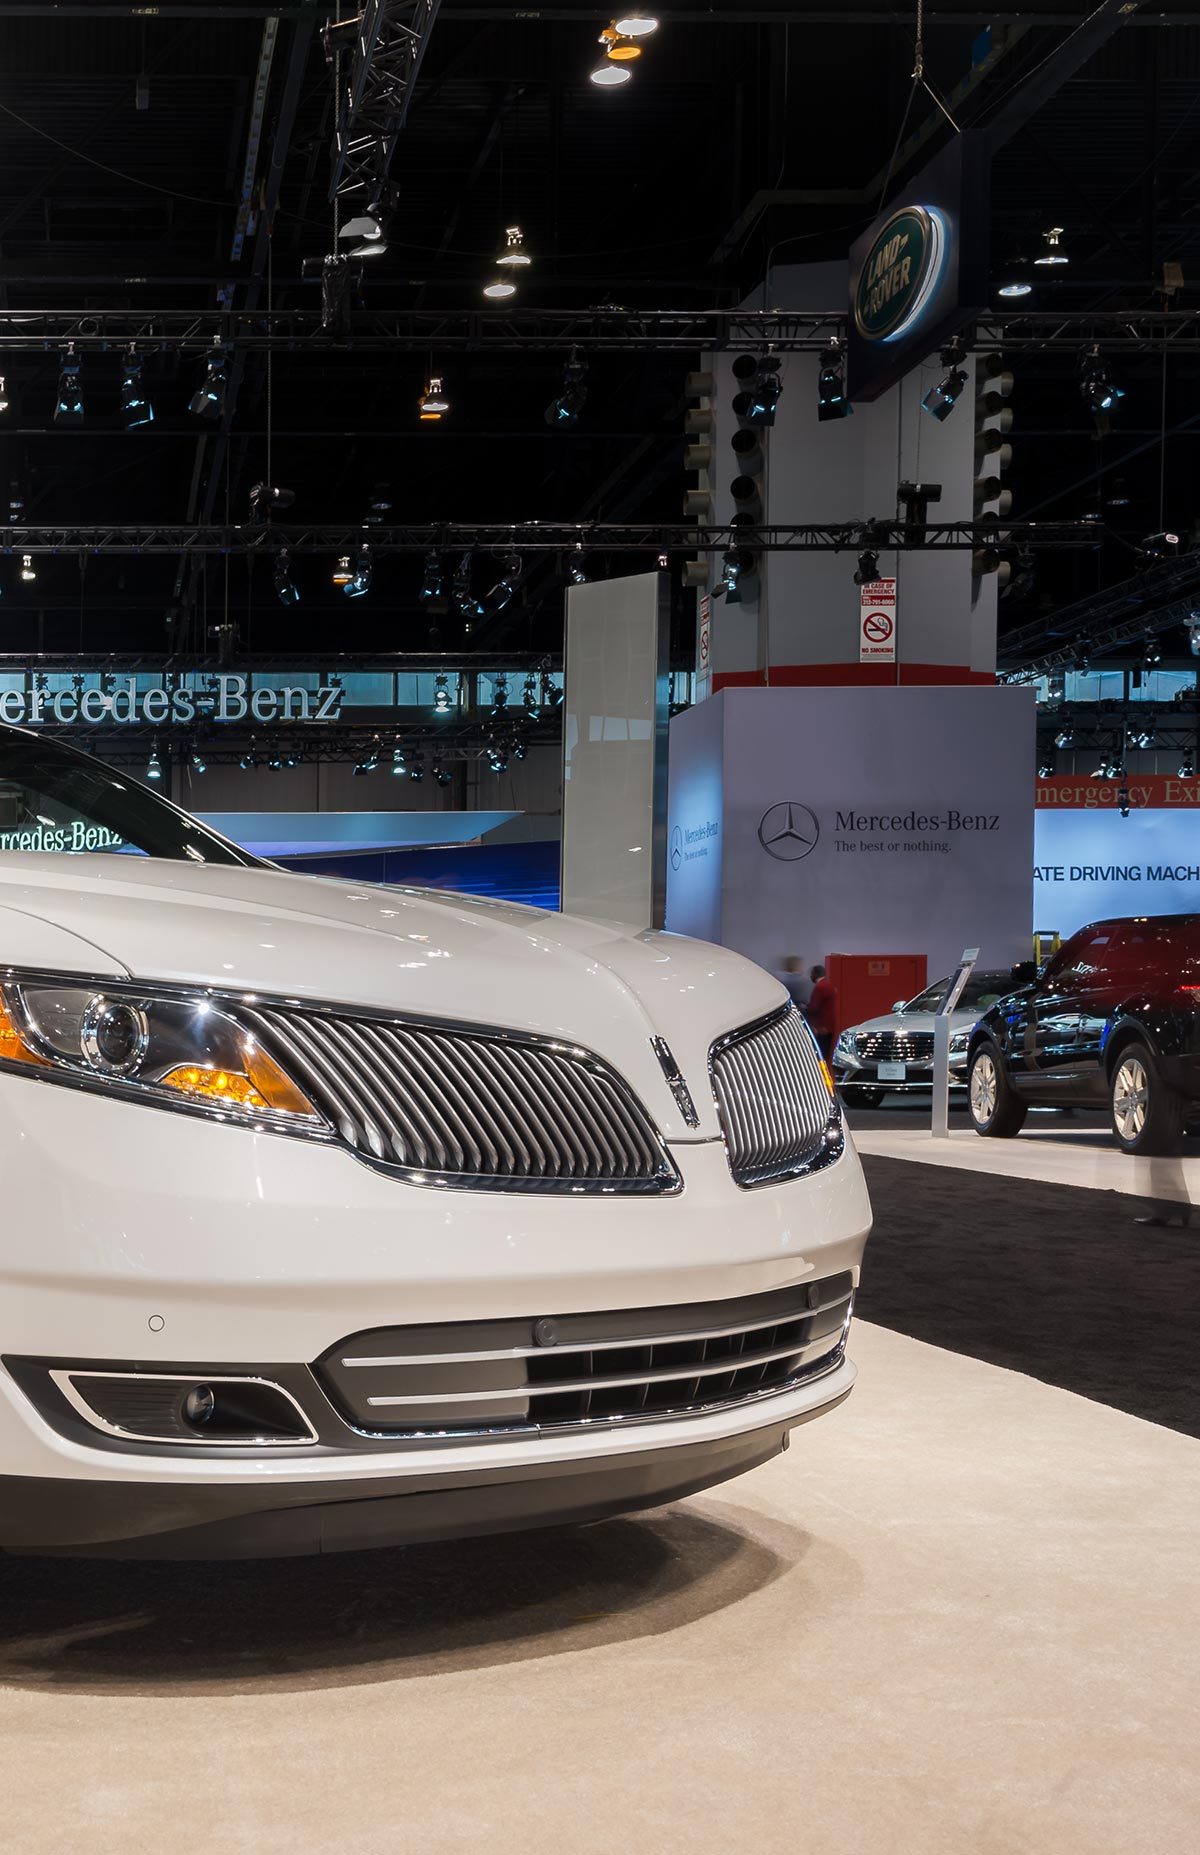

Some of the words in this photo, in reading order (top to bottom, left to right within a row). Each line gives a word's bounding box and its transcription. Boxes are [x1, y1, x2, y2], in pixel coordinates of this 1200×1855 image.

[867, 234, 902, 290] LAND
[869, 256, 911, 318] ROVER
[834, 810, 1000, 831] Mercedes-Benz
[834, 840, 856, 852] The
[860, 840, 884, 852] best
[887, 843, 900, 852] or
[903, 840, 952, 854] nothing.
[1070, 866, 1141, 881] DRIVING
[1147, 866, 1199, 881] MACH
